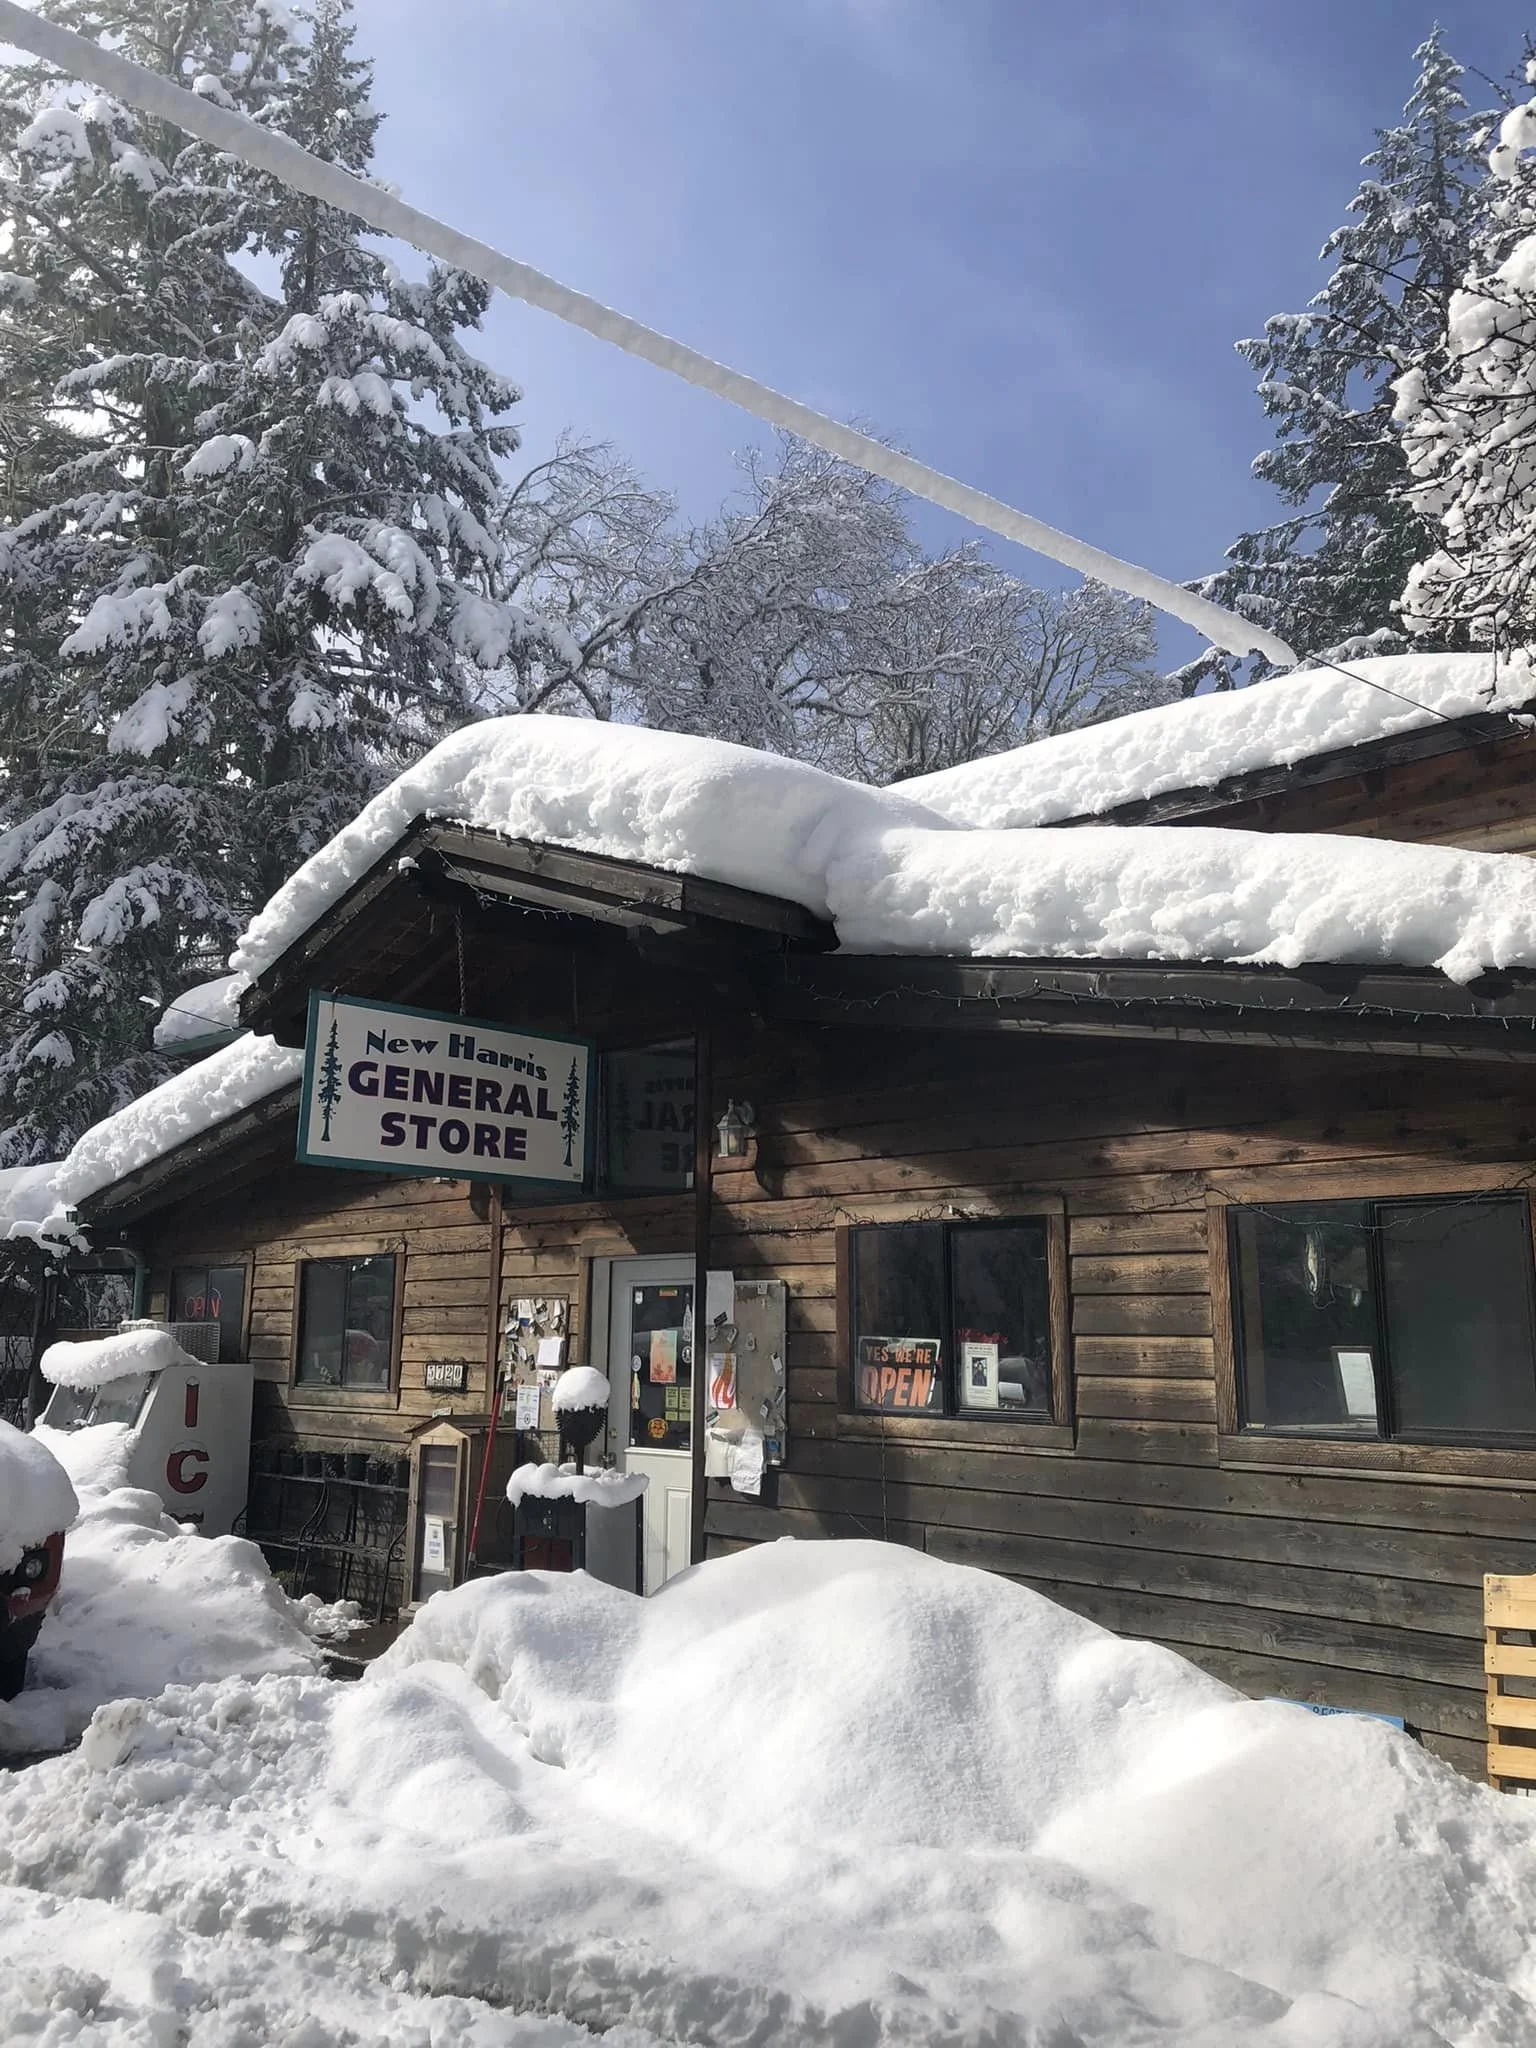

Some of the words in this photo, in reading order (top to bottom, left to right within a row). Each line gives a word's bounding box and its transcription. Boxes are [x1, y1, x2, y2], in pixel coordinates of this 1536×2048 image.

[366, 1029, 439, 1055] New
[348, 1060, 558, 1121] GENERAL
[380, 1111, 528, 1161] STORE
[865, 1345, 889, 1362] YES
[861, 1365, 932, 1407] OPEN
